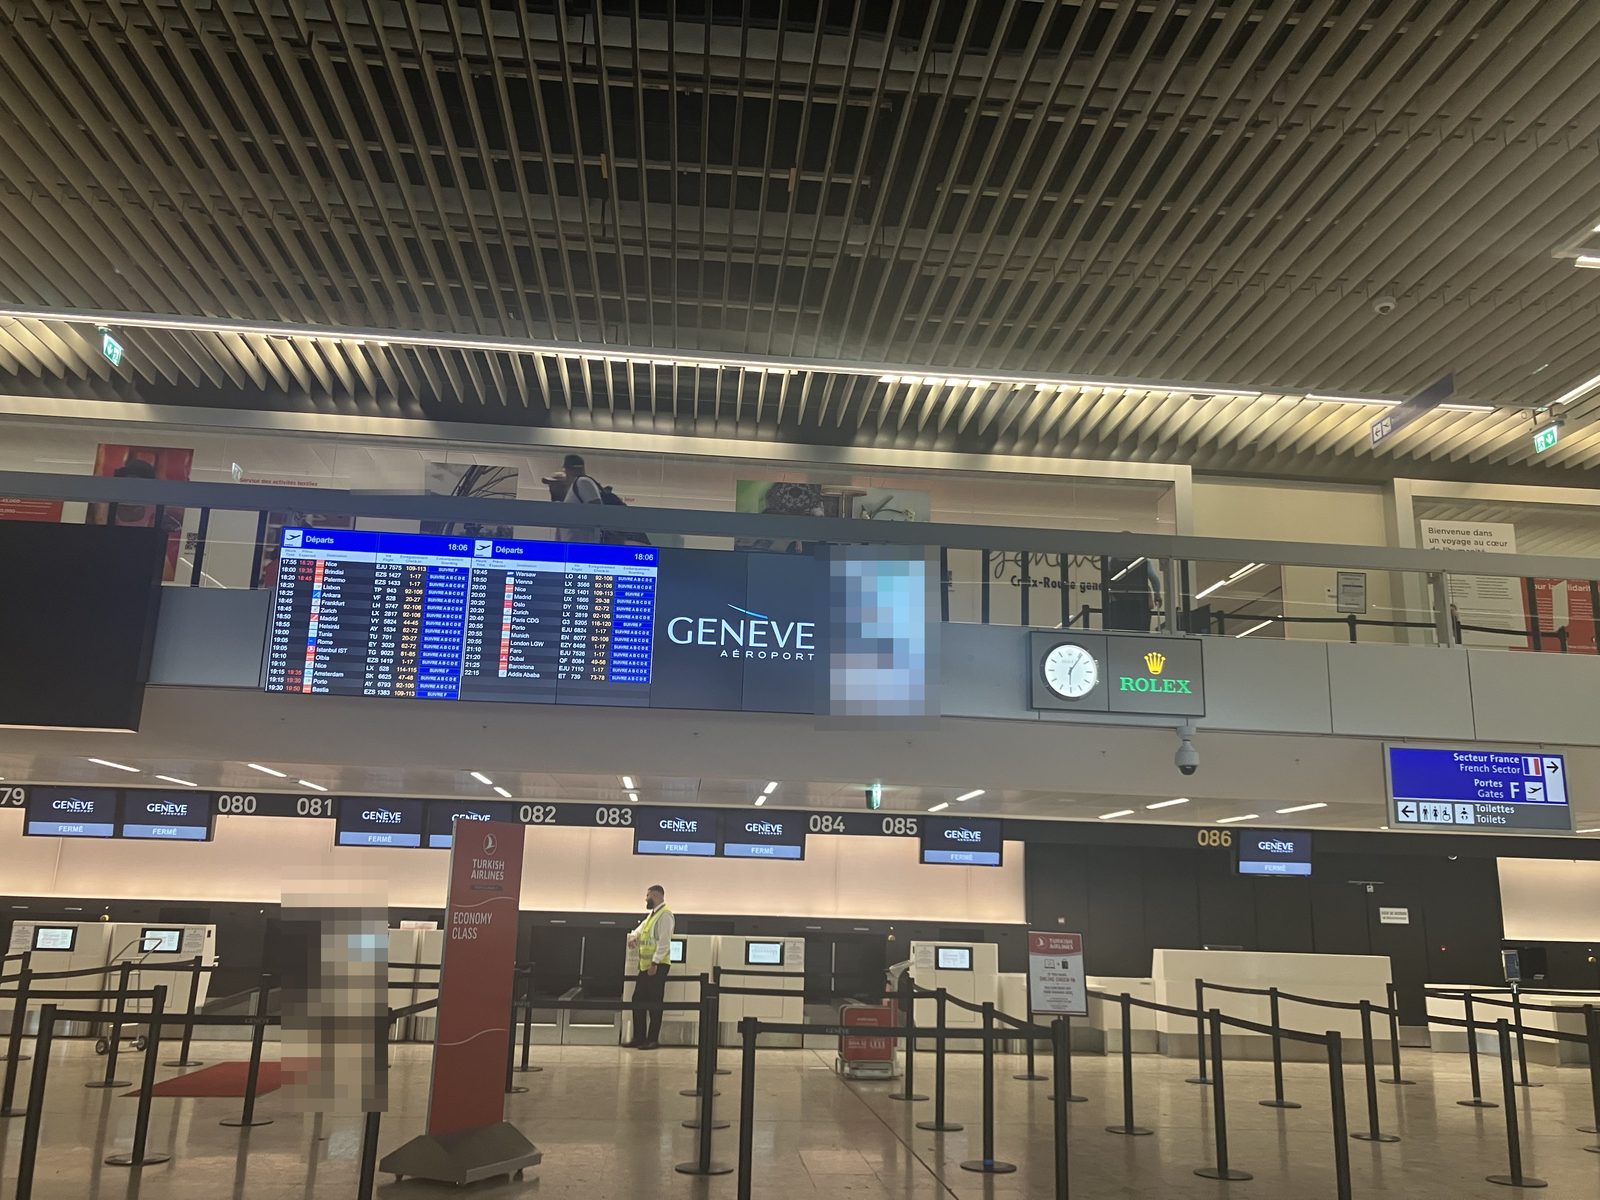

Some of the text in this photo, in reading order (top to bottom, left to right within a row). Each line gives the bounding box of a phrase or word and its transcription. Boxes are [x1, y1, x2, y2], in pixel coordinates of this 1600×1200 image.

[1428, 527, 1493, 537] Bienvenue dans
[305, 535, 334, 545] Départs
[1441, 538, 1472, 547] voyage
[495, 546, 524, 555] Départs
[720, 649, 815, 661] AÉROPORT
[1120, 676, 1192, 694] ROLEX
[1453, 752, 1520, 764] Secteur France
[1459, 763, 1521, 774] French Sector
[1474, 778, 1503, 788] Portes
[1477, 789, 1504, 799] Gates
[1510, 782, 1520, 799] F
[218, 794, 257, 814] 080
[296, 797, 333, 816] 081
[1474, 804, 1515, 814] Toilettes
[519, 805, 556, 823] 082
[595, 807, 632, 825] 083
[1475, 814, 1506, 825] Toilets
[58, 825, 84, 833] FERMÉ
[809, 814, 846, 833] 084
[882, 817, 918, 835] 085
[152, 827, 178, 836] FERMÉ
[367, 835, 392, 843] FERMÉ
[1197, 829, 1232, 847] 086
[472, 859, 505, 870] TURKISH
[470, 870, 504, 880] AIRLINES
[453, 911, 493, 925] ECONOMY
[452, 927, 478, 940] CLASS
